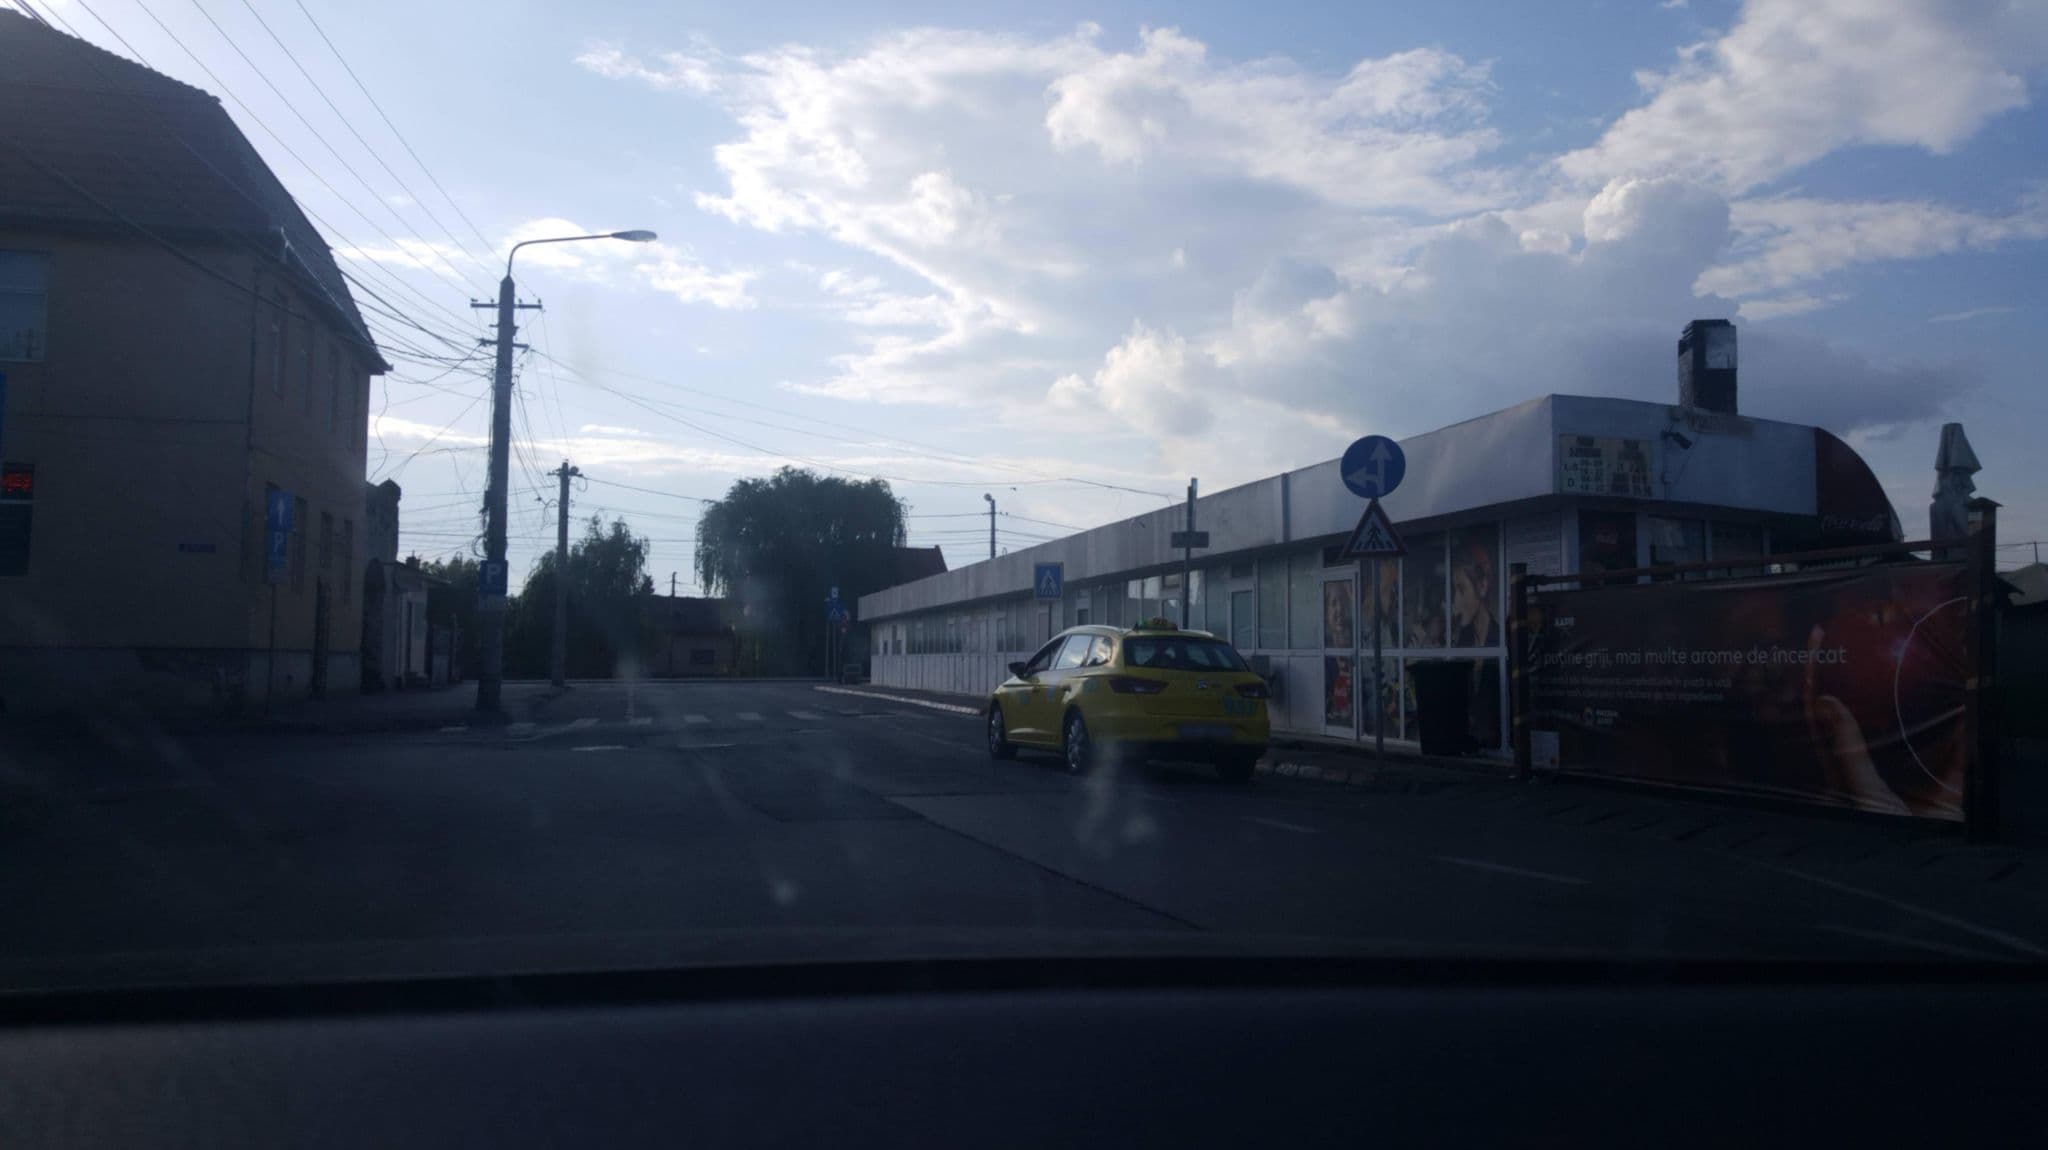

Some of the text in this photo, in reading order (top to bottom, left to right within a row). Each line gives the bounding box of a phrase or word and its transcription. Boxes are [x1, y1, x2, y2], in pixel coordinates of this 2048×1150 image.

[274, 531, 284, 552] P
[486, 563, 502, 584] P
[1616, 648, 1640, 664] mai
[1645, 646, 1689, 664] multe
[1691, 648, 1743, 664] arome
[1747, 643, 1768, 664] de
[1769, 644, 1848, 664] încercat
